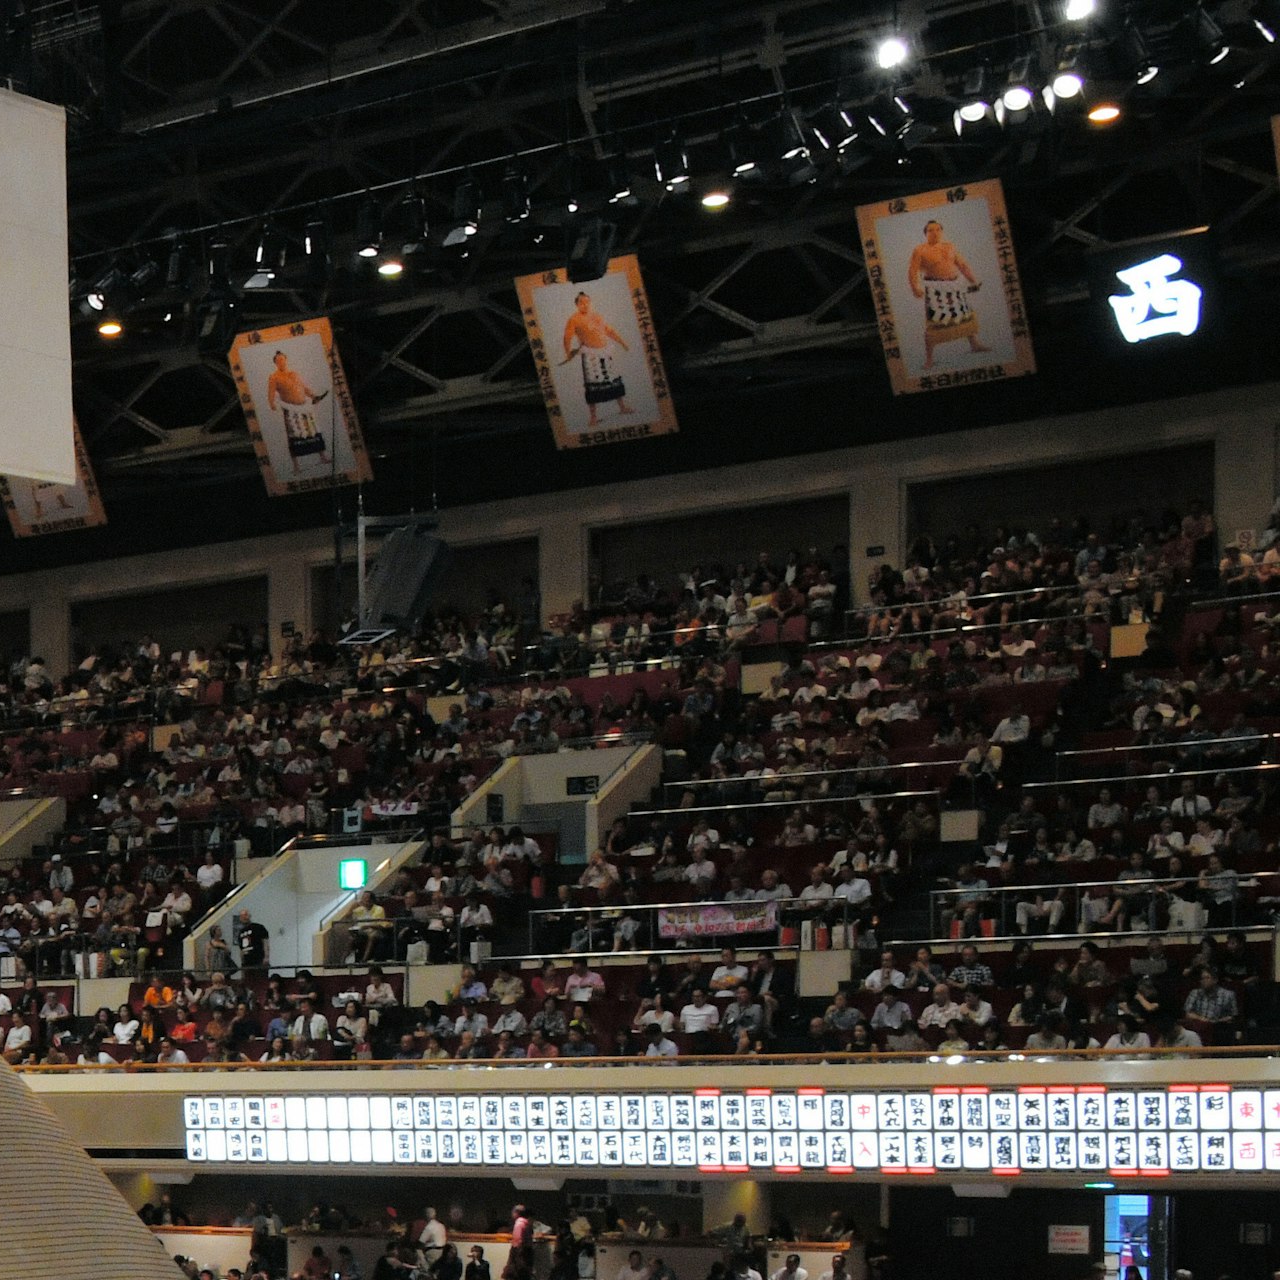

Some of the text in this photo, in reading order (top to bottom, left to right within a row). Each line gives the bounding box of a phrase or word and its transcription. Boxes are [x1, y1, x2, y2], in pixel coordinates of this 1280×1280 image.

[1108, 253, 1202, 343] 西
[858, 1104, 870, 1119] 中
[885, 1099, 900, 1126] 千代丸
[911, 1099, 926, 1125] 臥牙丸
[1239, 1101, 1254, 1118] 東
[605, 1136, 617, 1160] 石浦
[630, 1136, 641, 1160] 正代
[858, 1141, 871, 1156] 入
[886, 1136, 900, 1162] 一山本
[1240, 1142, 1256, 1159] 西
